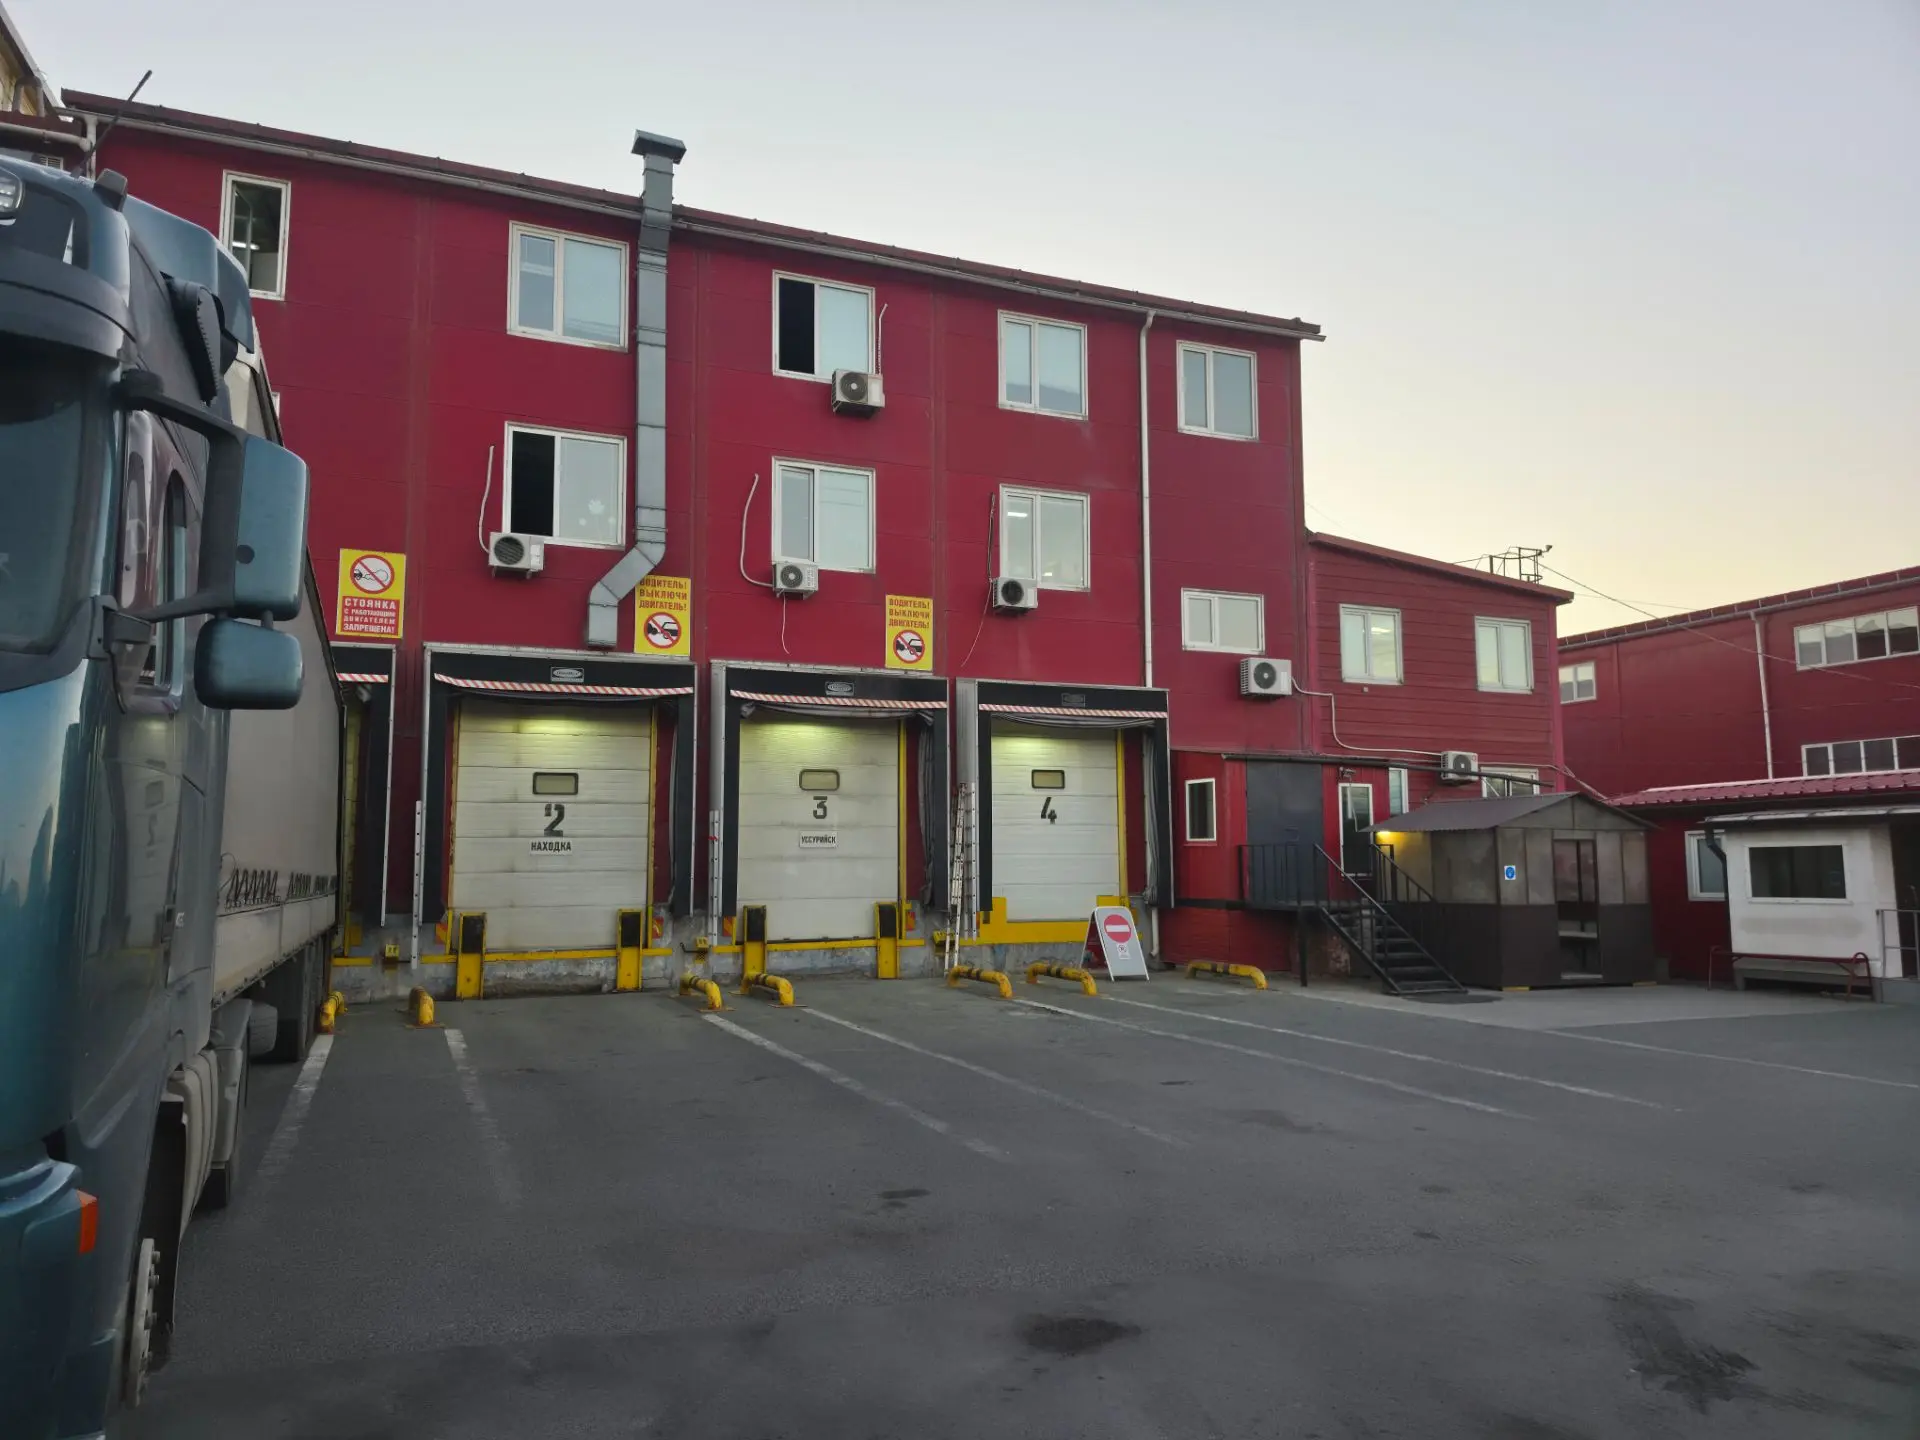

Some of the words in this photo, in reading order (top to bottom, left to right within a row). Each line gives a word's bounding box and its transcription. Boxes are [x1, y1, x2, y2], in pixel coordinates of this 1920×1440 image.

[639, 589, 688, 600] ВЫКЛЮЧИ
[344, 598, 396, 609] СТОЯНКА
[639, 600, 687, 611] ДВИГАТЕЛЬ!
[889, 598, 930, 609] ВОДИТЕЛЬ!
[889, 609, 930, 619] ВЫКЛЮЧИ
[343, 623, 396, 634] ЗАПРЕЩЕНА!
[813, 796, 828, 819] 3
[1041, 796, 1057, 825] 4
[544, 803, 565, 837] 2
[530, 841, 572, 853] НАХОДКА
